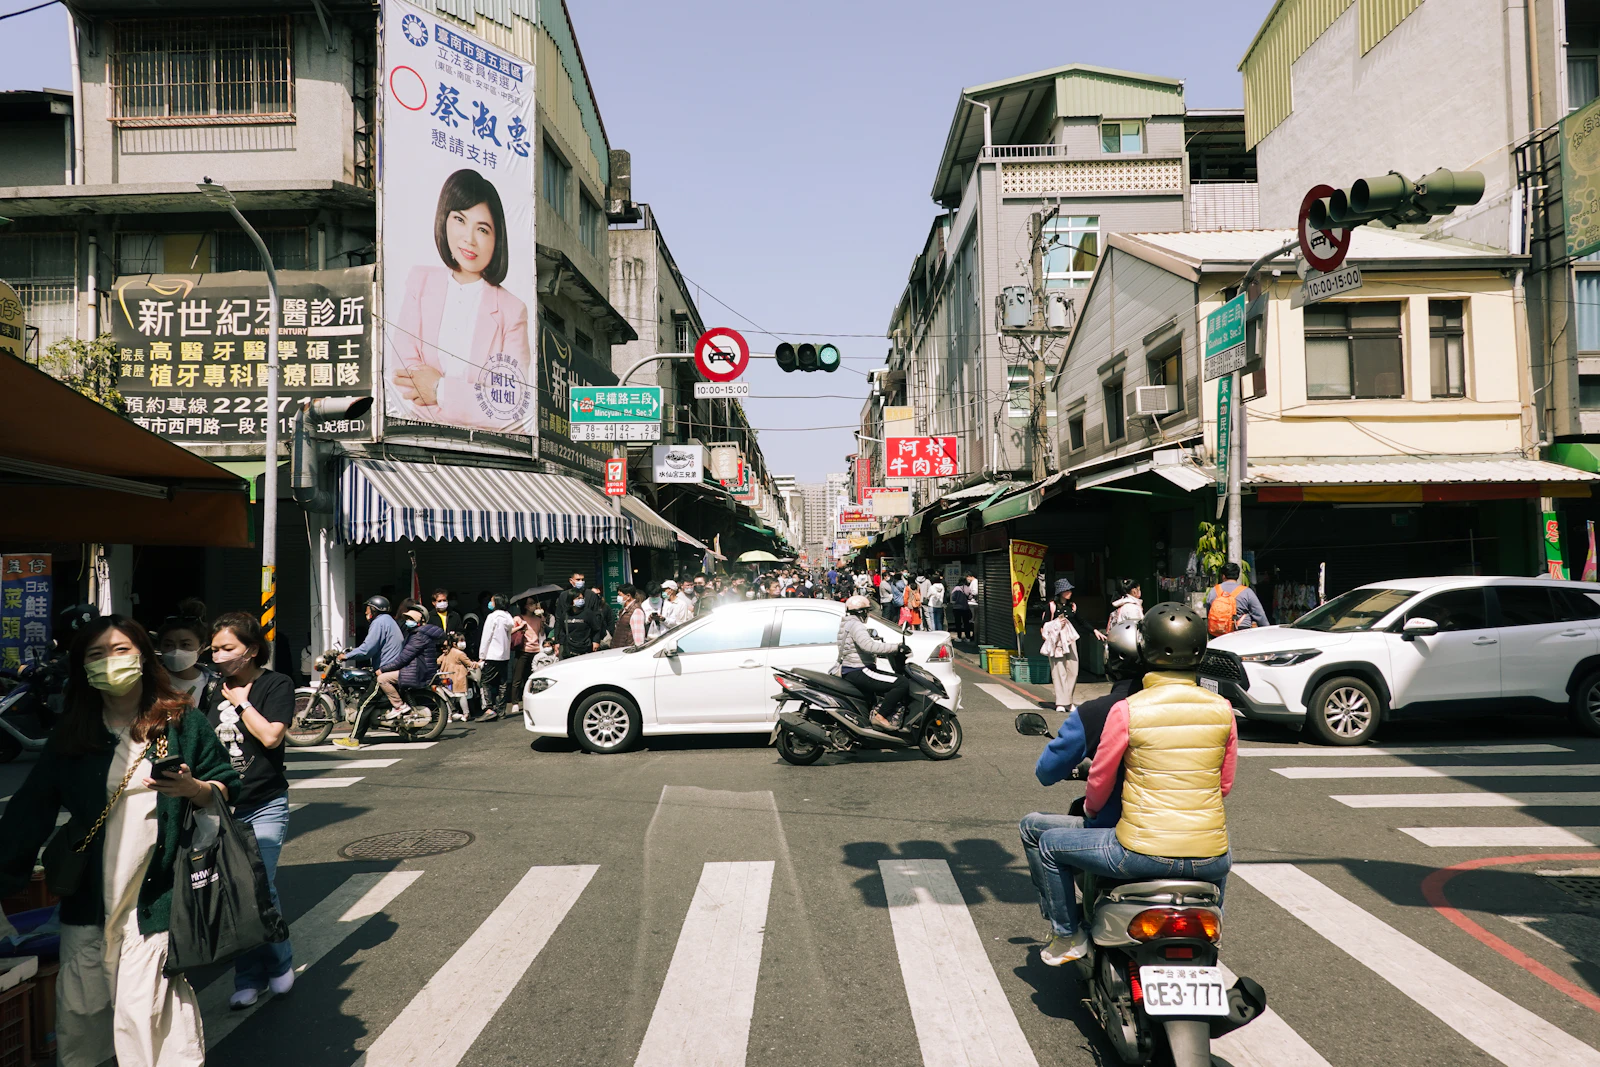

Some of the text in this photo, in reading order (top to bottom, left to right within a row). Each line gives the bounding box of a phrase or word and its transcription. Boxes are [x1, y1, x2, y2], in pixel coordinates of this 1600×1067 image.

[437, 26, 522, 80] 臺南市第五選區
[437, 46, 521, 95] 立法委員候選人
[430, 82, 531, 158] 蔡淑惠
[431, 128, 498, 169] 懇請支持
[1309, 270, 1359, 297] 10:00-15:00
[138, 295, 364, 337] 新世紀牙醫診所
[120, 340, 360, 362] 院長 高醫牙醫學碩士
[490, 371, 516, 389] 國民
[490, 388, 516, 406] 姐姐
[595, 392, 652, 405] 民權路三段
[697, 385, 748, 395] 10:00-15:00
[124, 396, 208, 415] 預約專線
[571, 424, 581, 433] 西
[651, 424, 660, 434] 東
[558, 444, 587, 466] 2227111
[898, 438, 946, 457] 阿村
[889, 457, 954, 475] 牛肉湯
[934, 538, 968, 553] 牛肉湯
[26, 581, 49, 593] 日式
[2, 587, 24, 669] 菜頭湯
[1166, 969, 1198, 979] 台灣省
